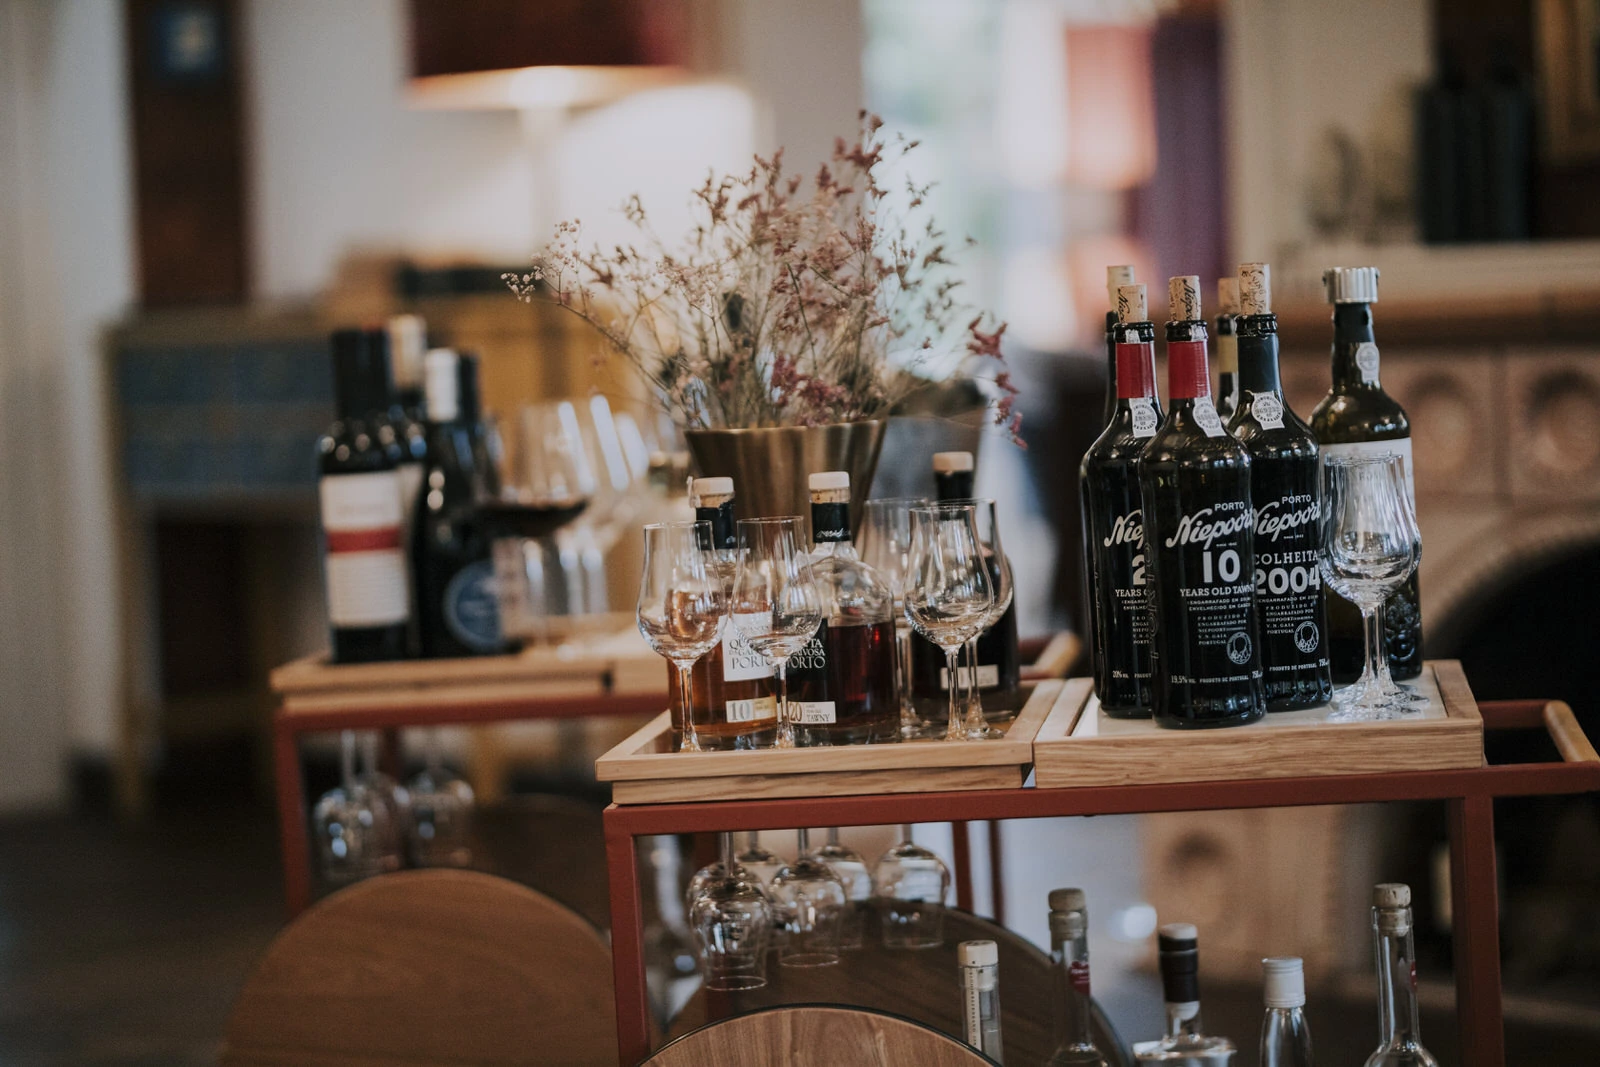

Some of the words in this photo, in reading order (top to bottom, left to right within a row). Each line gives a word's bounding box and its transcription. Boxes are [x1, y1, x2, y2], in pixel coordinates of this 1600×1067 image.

[1214, 501, 1245, 511] PORTO
[1281, 495, 1311, 504] PORTO
[1132, 554, 1146, 585] 2
[1203, 549, 1241, 583] 10
[1256, 565, 1320, 595] 2004
[1115, 588, 1142, 597] YEARS
[1180, 587, 1210, 597] YEARS
[1211, 586, 1231, 596] OLD
[730, 702, 751, 721] 10
